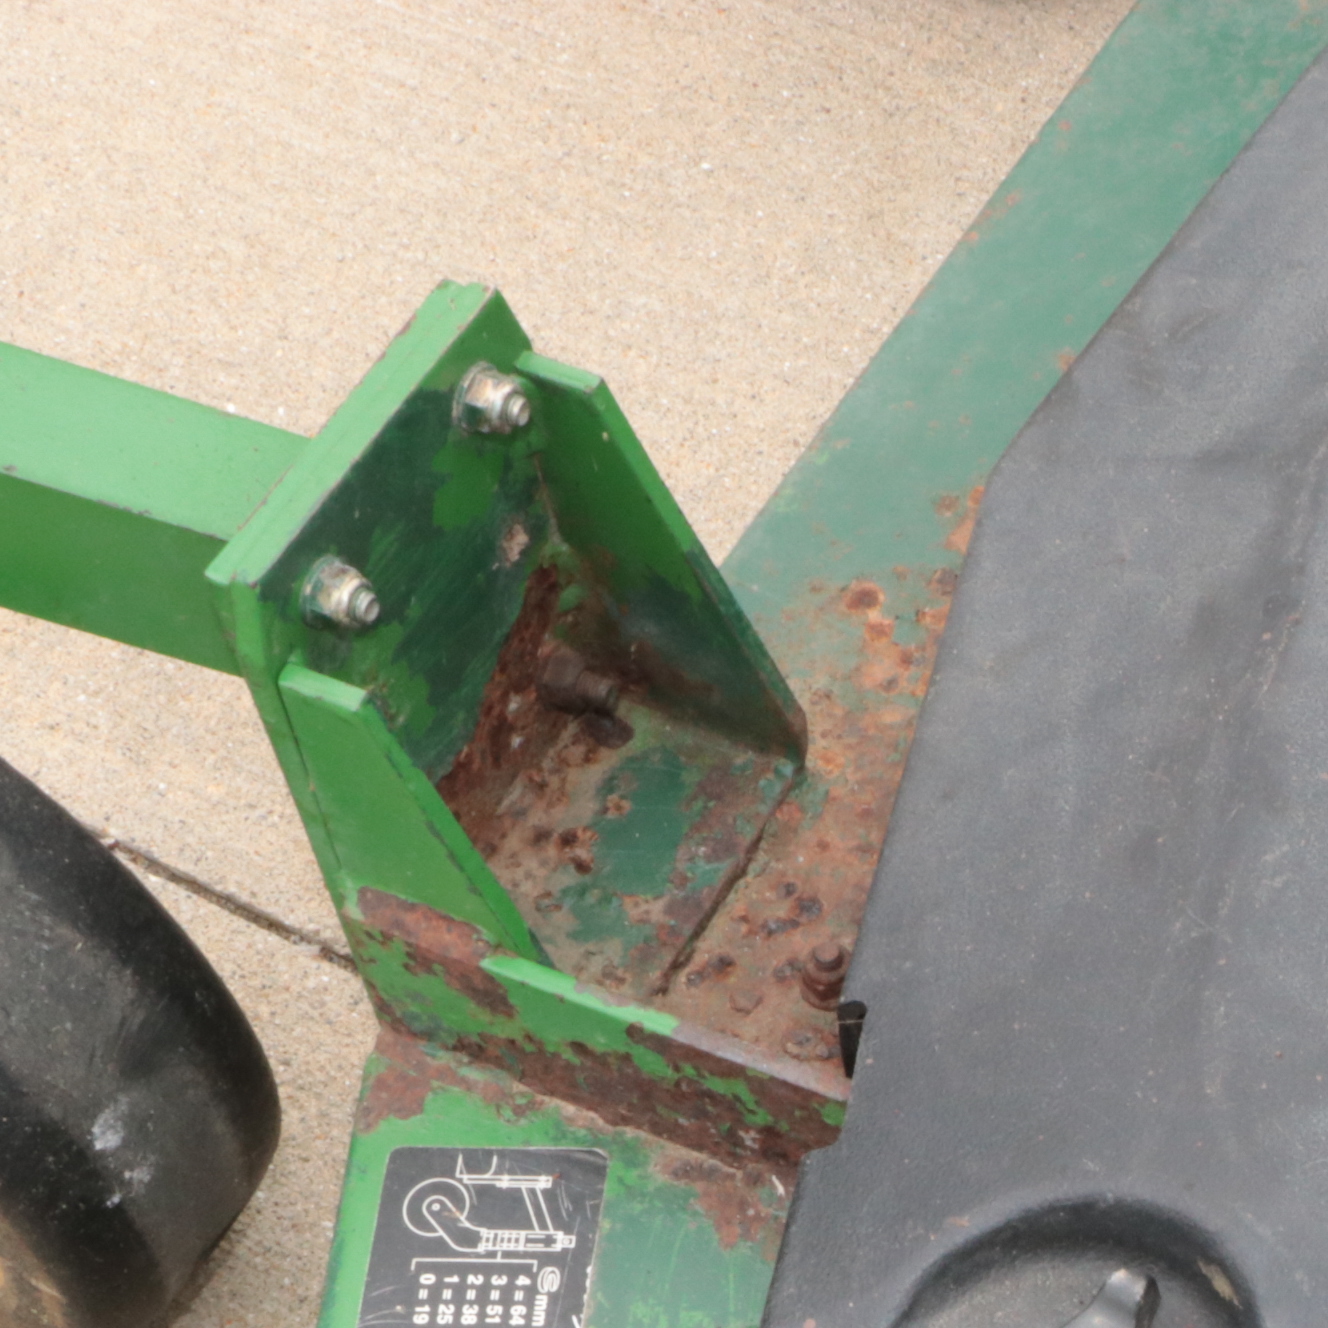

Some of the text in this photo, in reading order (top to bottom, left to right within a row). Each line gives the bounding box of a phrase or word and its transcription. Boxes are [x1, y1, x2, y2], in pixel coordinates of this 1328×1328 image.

[419, 1274, 436, 1285] 0
[444, 1274, 460, 1283] 1
[467, 1274, 484, 1285] 2
[491, 1274, 508, 1286] 3
[515, 1275, 531, 1286] 4
[418, 1289, 428, 1299] =
[442, 1289, 452, 1299] =
[466, 1289, 476, 1300] =
[490, 1290, 500, 1301] =
[514, 1290, 523, 1301] =
[413, 1304, 430, 1324] 19
[437, 1304, 455, 1324] 25
[461, 1304, 479, 1325] 38
[485, 1305, 503, 1323] 51
[509, 1305, 527, 1325] 64
[532, 1294, 548, 1327] mm
